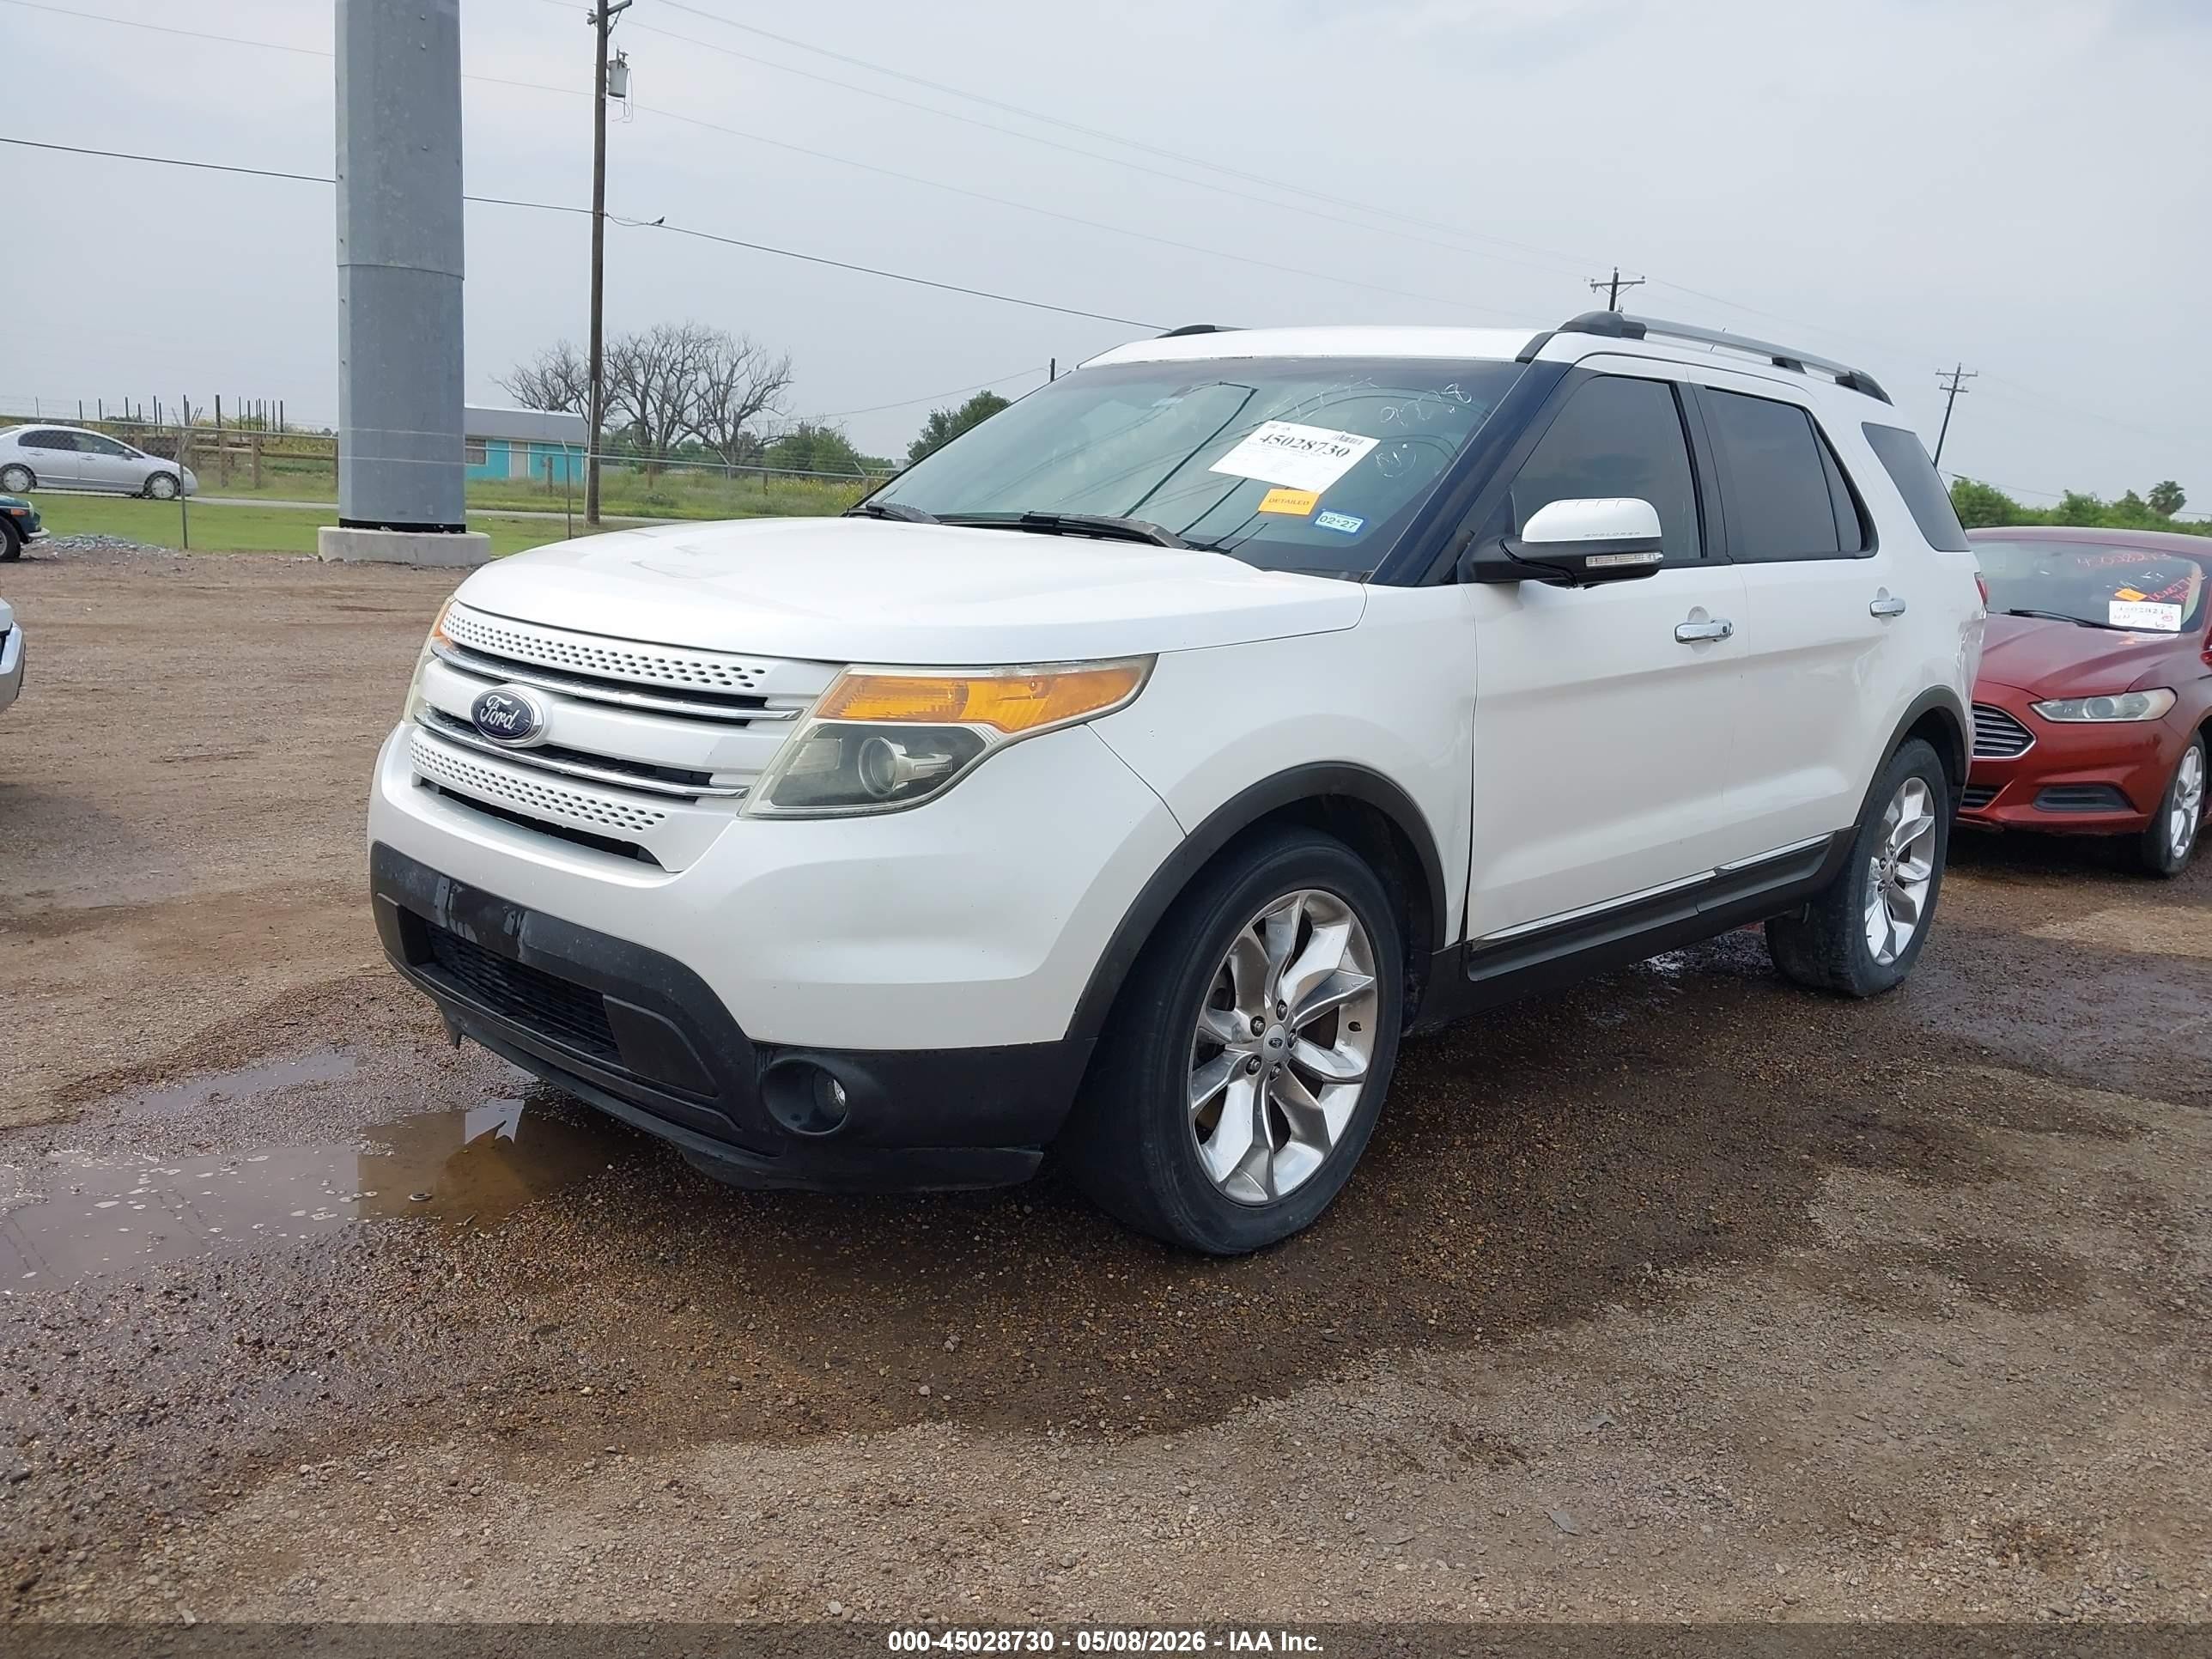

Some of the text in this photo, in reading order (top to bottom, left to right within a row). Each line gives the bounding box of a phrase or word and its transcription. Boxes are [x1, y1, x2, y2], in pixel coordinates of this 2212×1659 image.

[1260, 433, 1351, 458] 45028730
[1268, 497, 1310, 506] DETAILED
[479, 694, 521, 730] Ford
